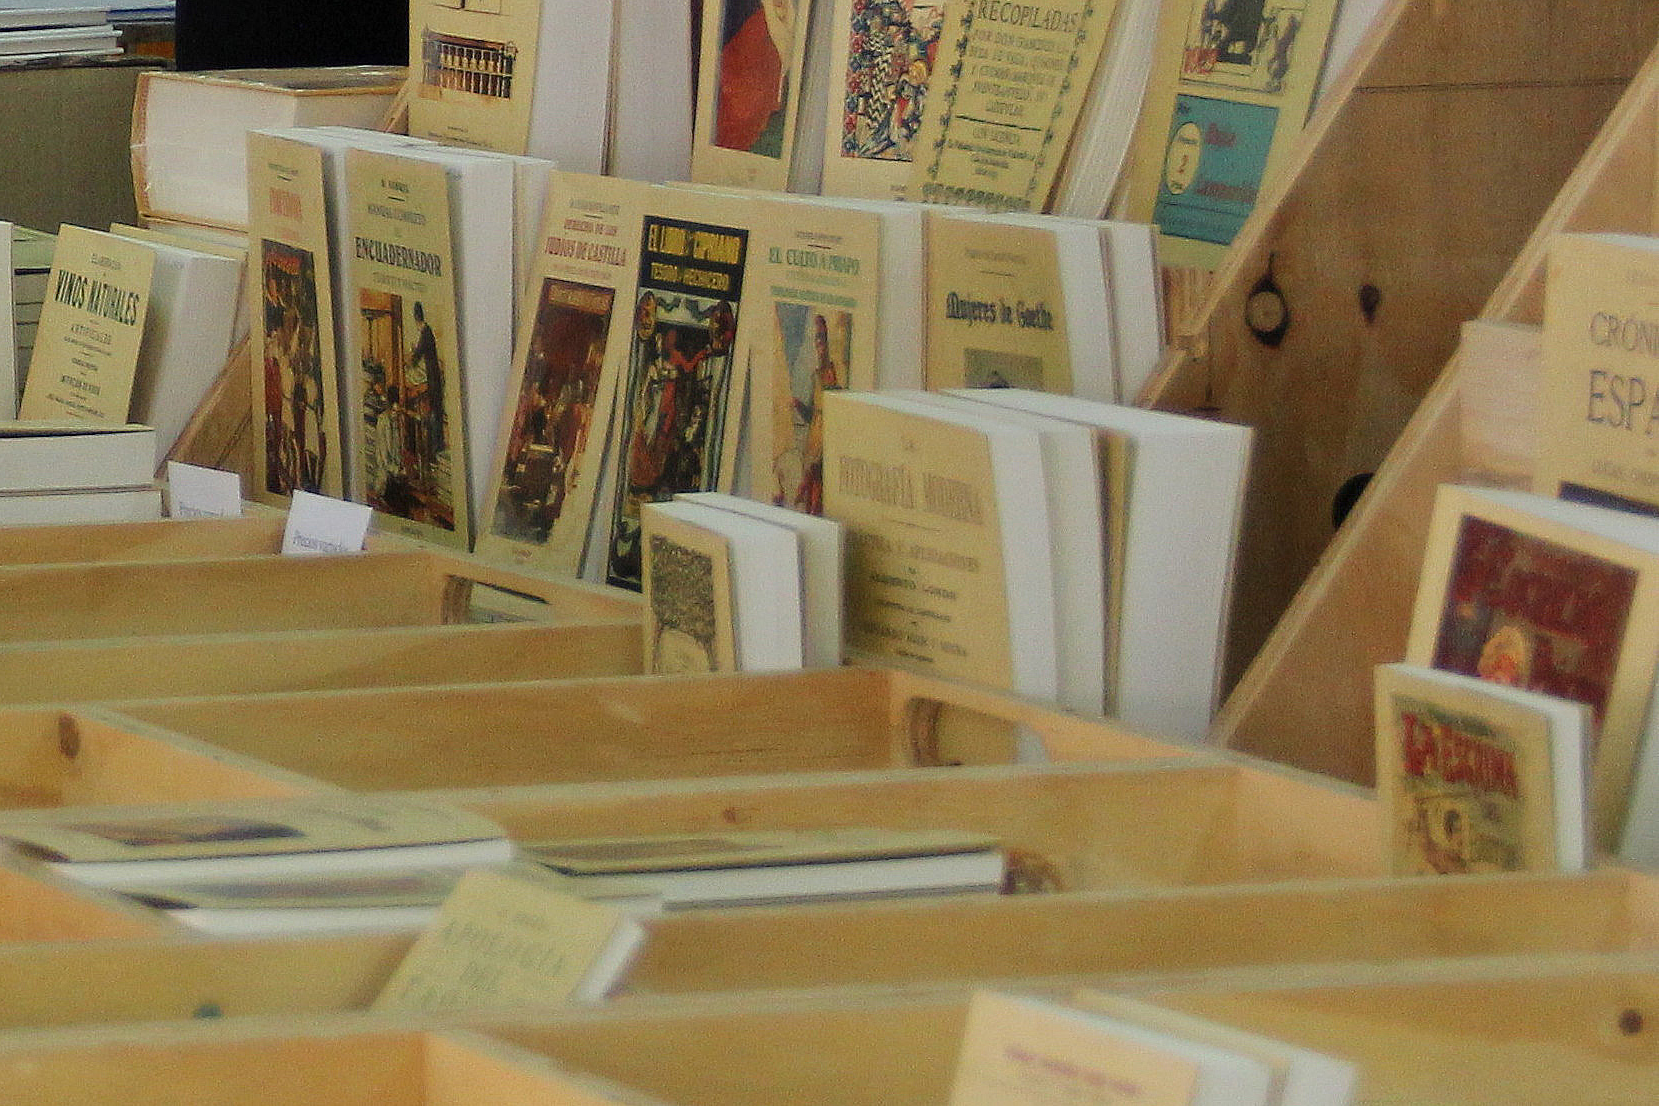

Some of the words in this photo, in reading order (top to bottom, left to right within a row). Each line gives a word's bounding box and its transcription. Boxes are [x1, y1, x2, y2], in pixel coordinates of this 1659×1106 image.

[354, 235, 443, 278] ENCUADERNADOR
[768, 246, 783, 264] EL
[55, 269, 88, 310] VINOS
[87, 279, 140, 327] NATURALES
